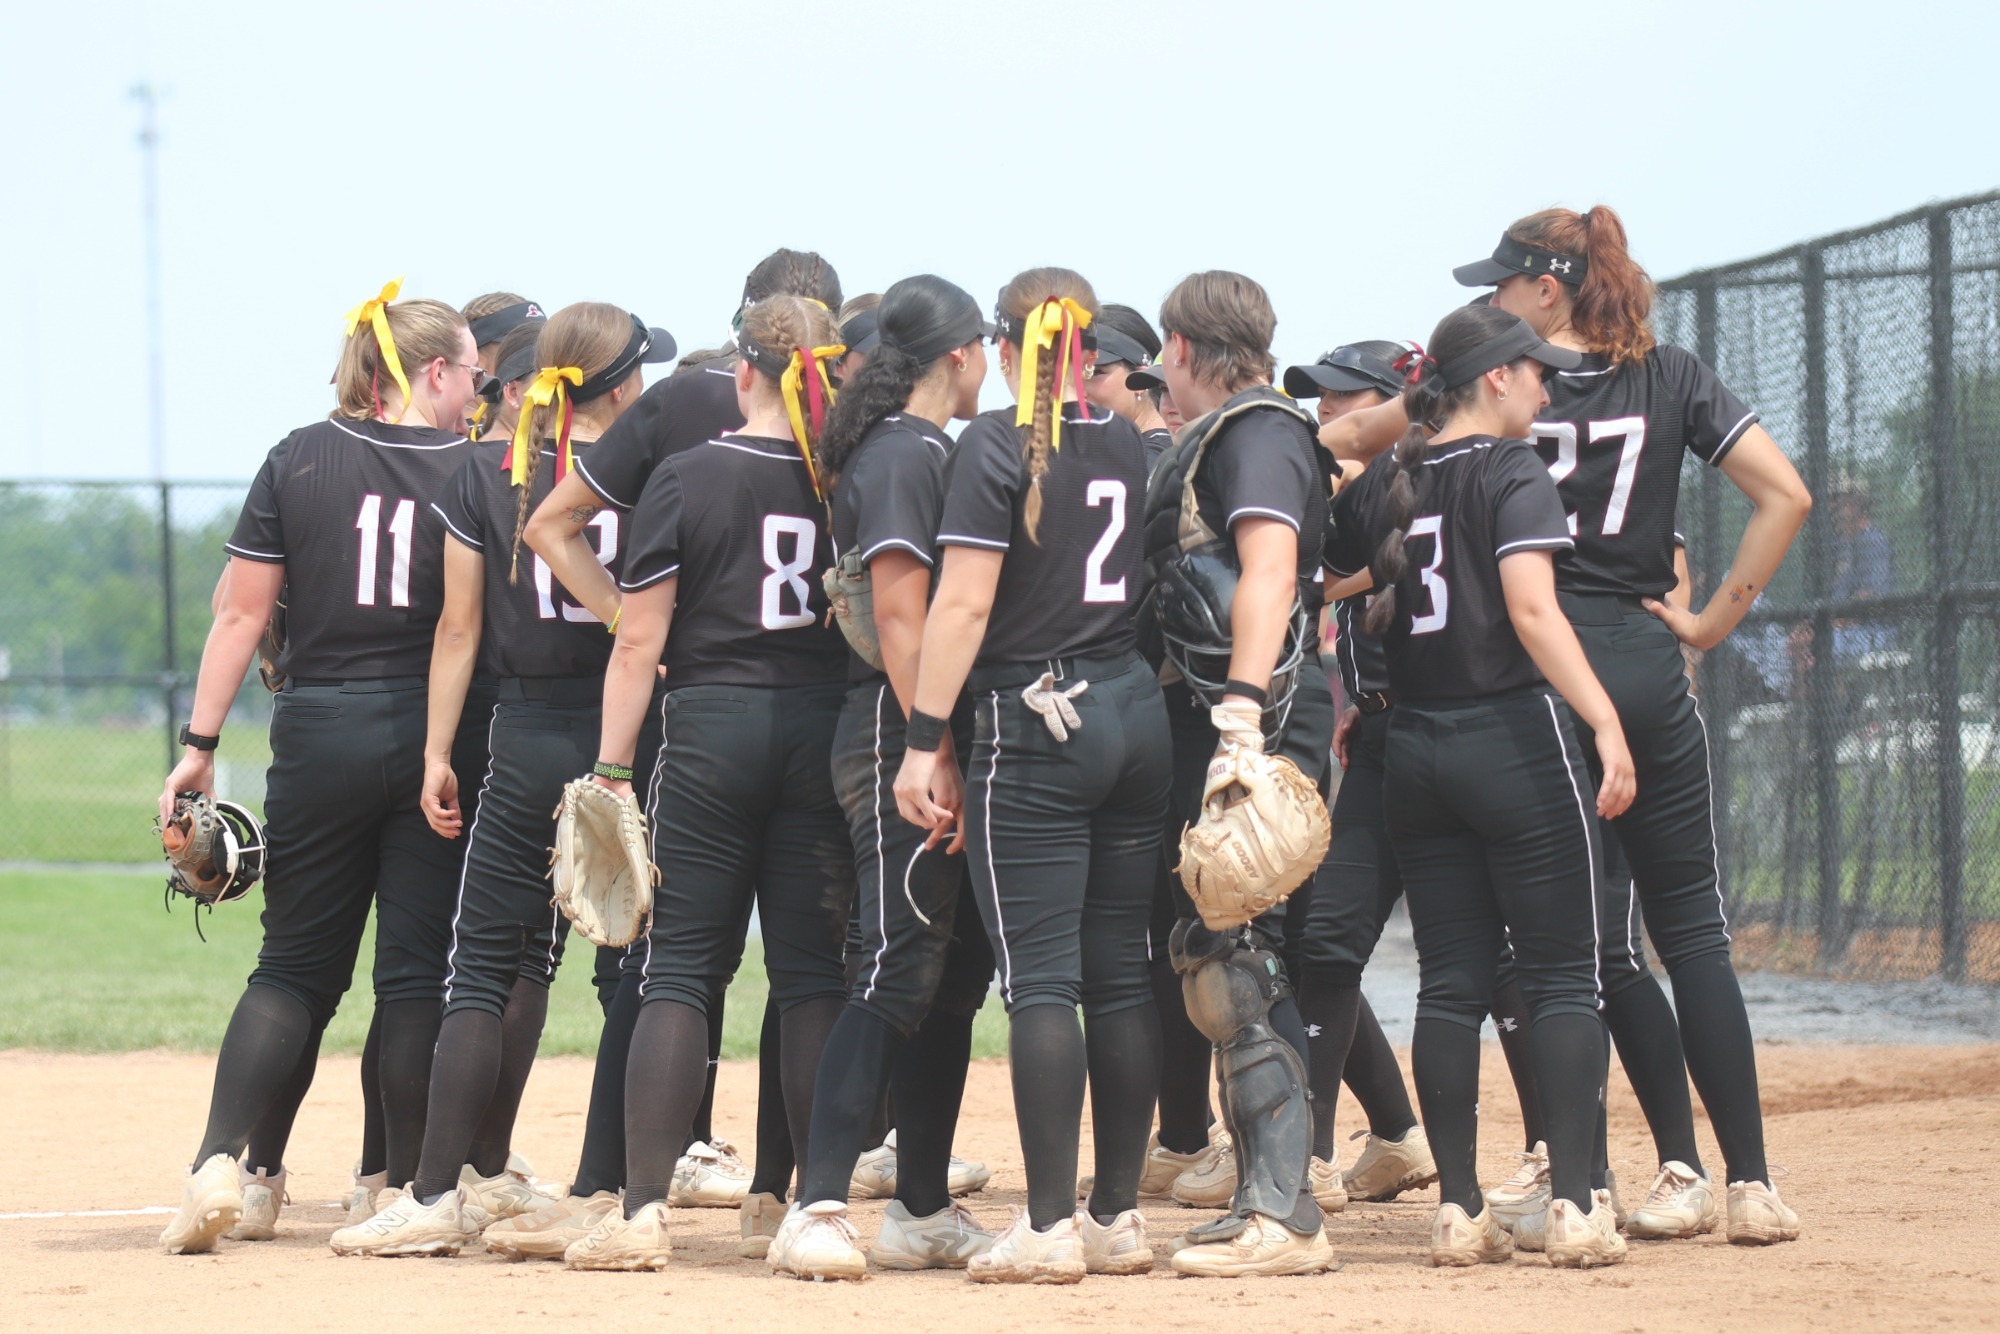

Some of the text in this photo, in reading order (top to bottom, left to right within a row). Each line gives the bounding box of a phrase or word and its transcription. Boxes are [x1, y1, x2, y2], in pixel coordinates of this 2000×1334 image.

[1523, 416, 1646, 536] 27
[354, 492, 416, 608] 11
[761, 513, 817, 631] 8
[1084, 478, 1127, 603] 2
[1402, 514, 1449, 635] 3
[1231, 840, 1260, 879] A2000
